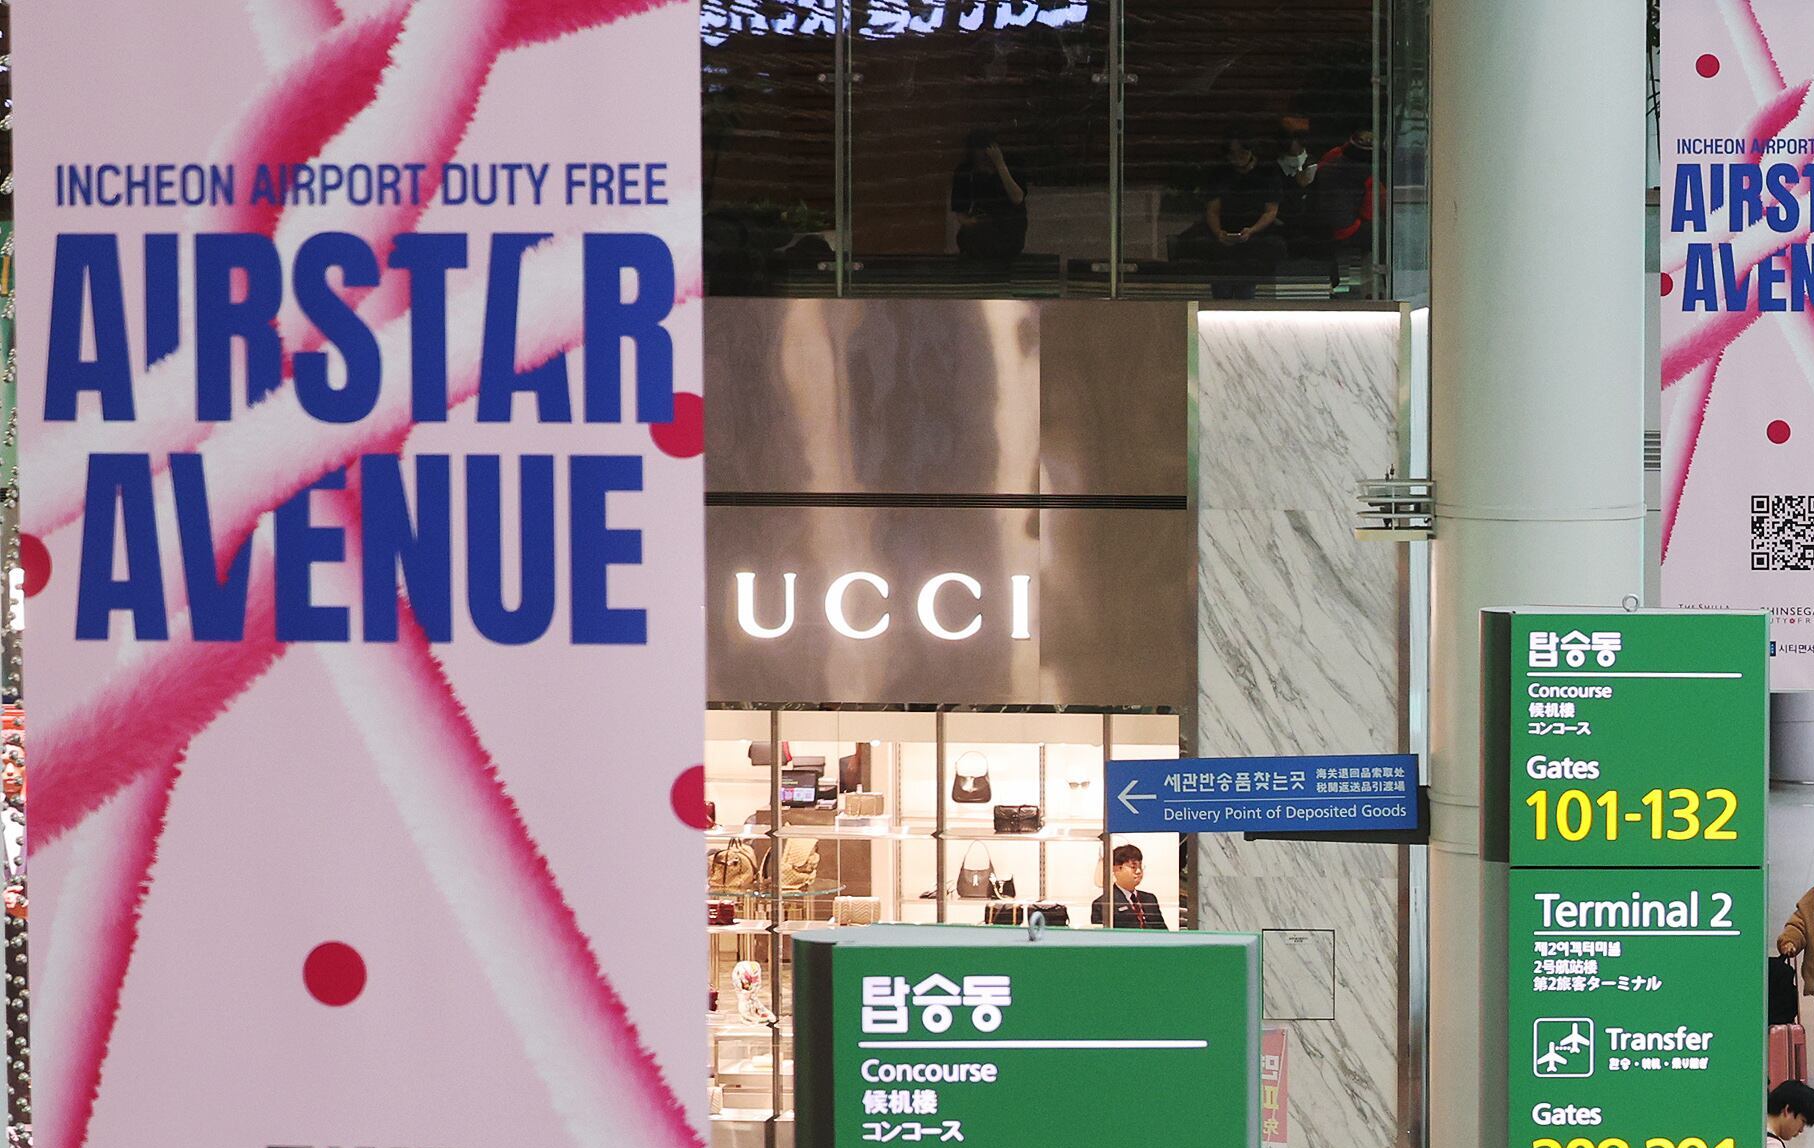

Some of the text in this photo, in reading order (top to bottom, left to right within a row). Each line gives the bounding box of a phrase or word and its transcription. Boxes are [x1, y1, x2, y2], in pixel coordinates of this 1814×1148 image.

[1676, 138, 1745, 155] INCHEON
[55, 163, 669, 207] INCHEON AIRPORT DUTY FREE
[43, 231, 676, 424] AIRSTAR
[75, 453, 648, 645] AVENUE
[735, 572, 1032, 641] UCCI
[1528, 630, 1622, 668] 탑승동
[1527, 682, 1613, 699] Concourse
[1528, 722, 1592, 735] コンコース
[1526, 754, 1600, 780] Gates
[1164, 803, 1407, 823] Delivery Point of Deposited Goods
[1525, 788, 1739, 842] 101-132
[1533, 890, 1733, 929] Terminal 2
[861, 973, 1012, 1034] 탑승동
[1605, 1025, 1714, 1052] Transfer
[860, 1058, 999, 1084] Concourse
[862, 1089, 938, 1115] 候机楼
[1531, 1102, 1602, 1126] Gates
[861, 1120, 965, 1143] コンコース
